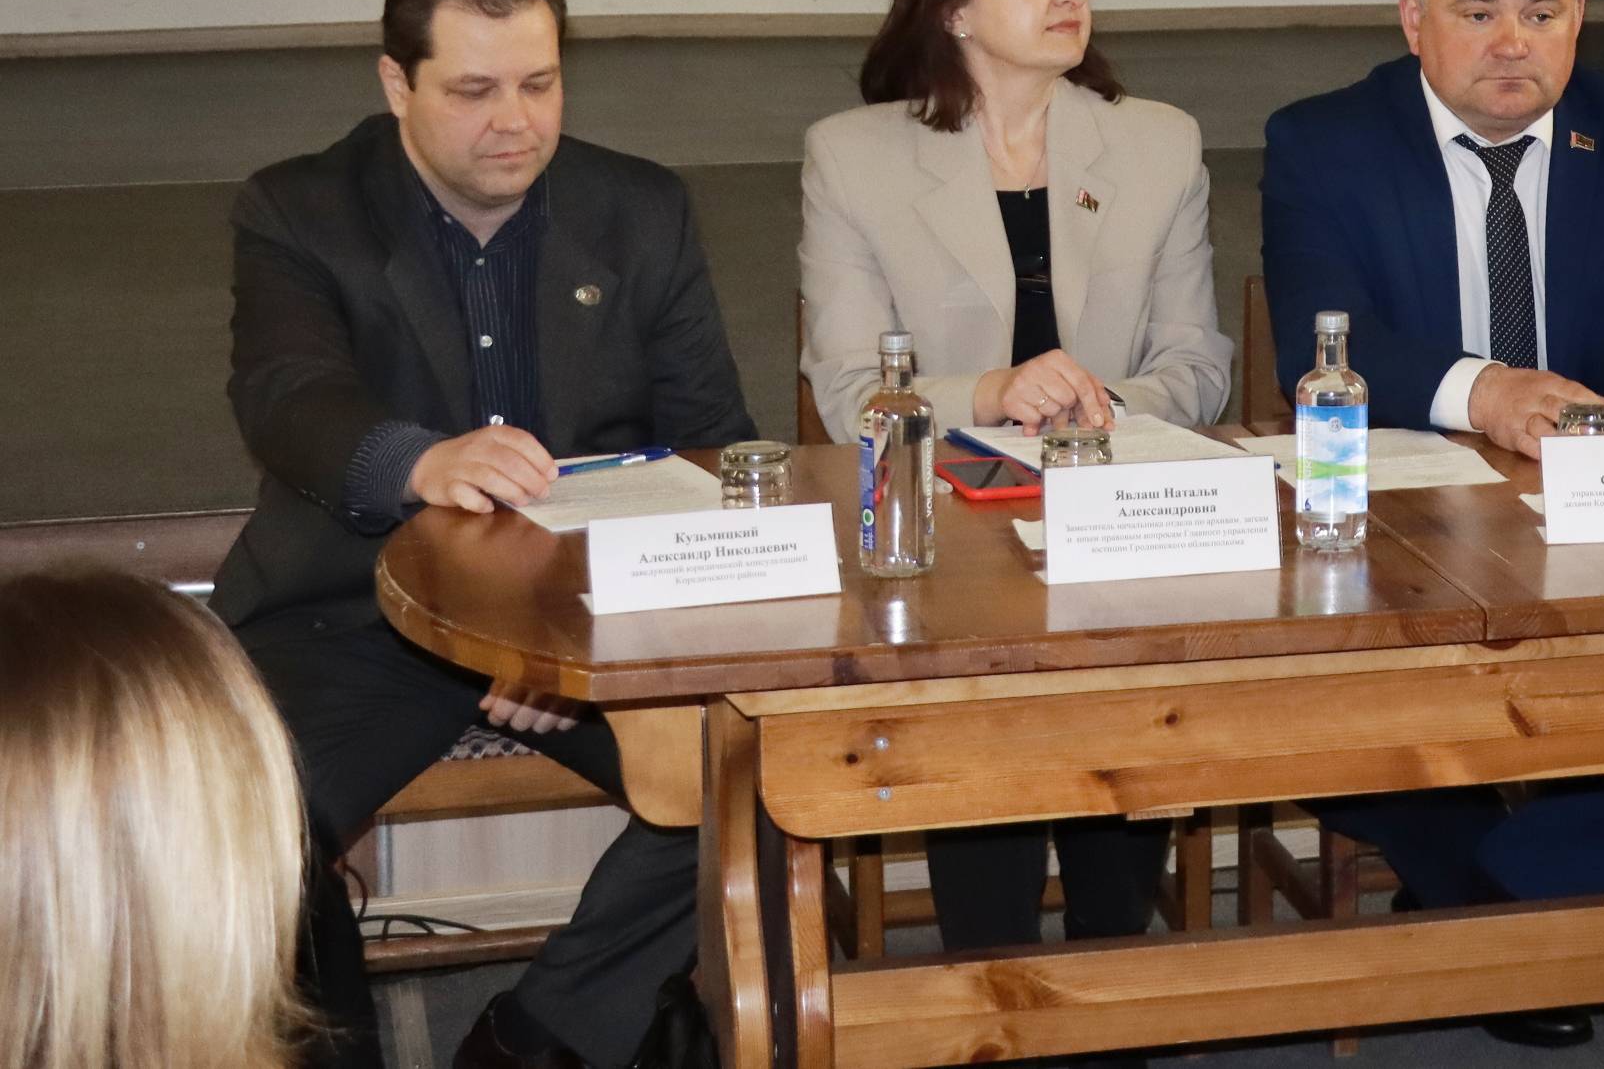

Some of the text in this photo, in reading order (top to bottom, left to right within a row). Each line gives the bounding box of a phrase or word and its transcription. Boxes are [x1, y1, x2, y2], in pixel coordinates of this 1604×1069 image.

[1115, 487, 1218, 501] Явлаш Наталья
[1118, 504, 1217, 518] Александровна
[675, 526, 759, 546] Кузьмицкий
[639, 542, 798, 564] Александр Николаевич
